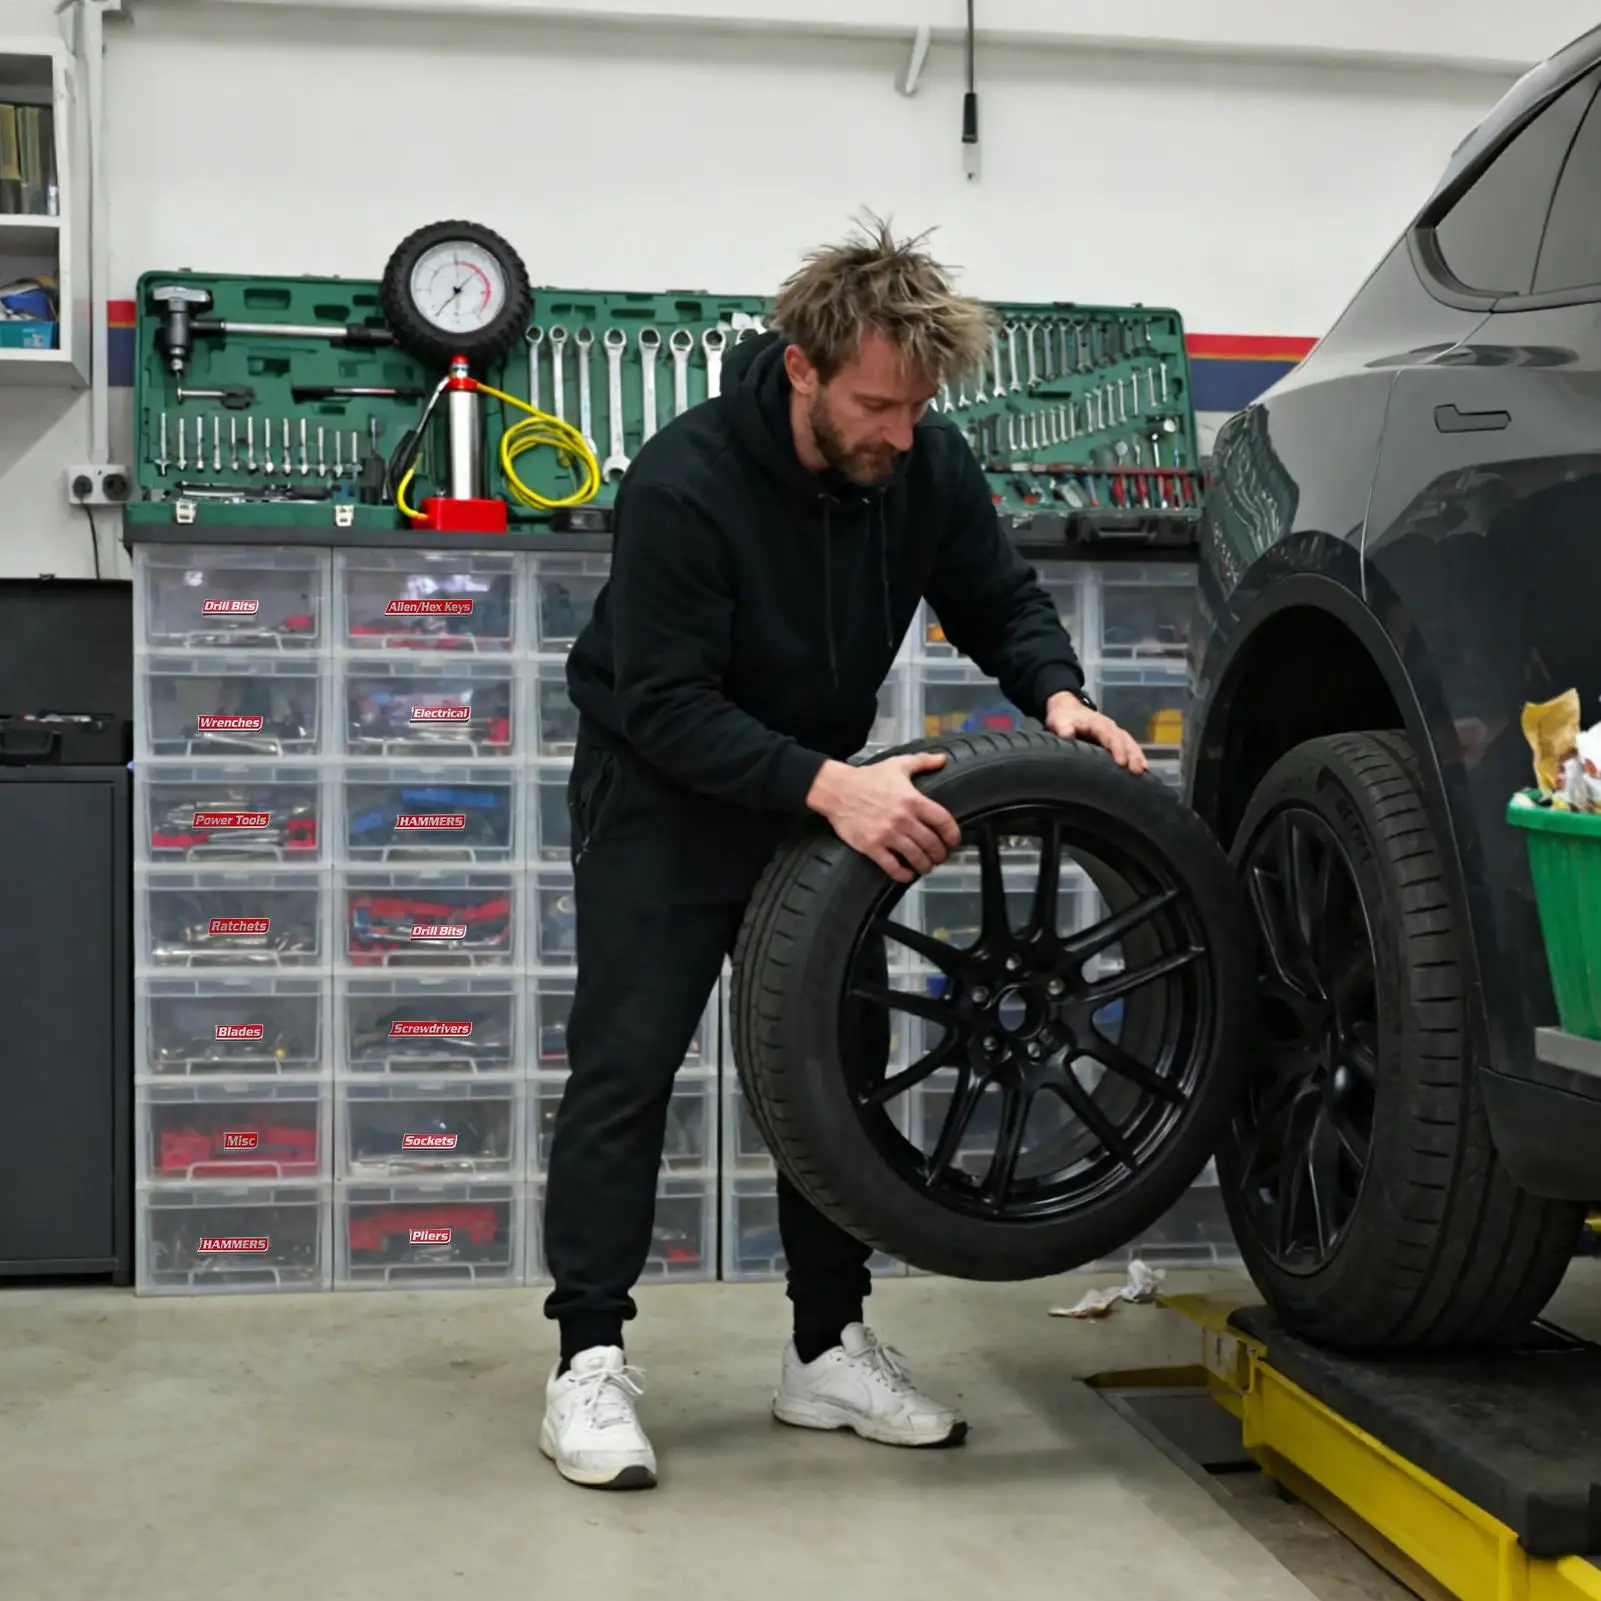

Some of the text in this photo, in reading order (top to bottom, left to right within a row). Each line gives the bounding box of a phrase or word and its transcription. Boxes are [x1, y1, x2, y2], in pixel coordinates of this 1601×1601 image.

[204, 600, 256, 611] Drill Bits
[387, 601, 470, 614] Allen/Hex Keys
[413, 708, 467, 718] Electrical
[200, 718, 260, 728] Wrenches
[196, 815, 266, 825] Power Tools
[400, 816, 463, 826] HAMMERS
[211, 921, 267, 931] Ratchets
[412, 926, 463, 937] Drill Bits
[218, 1027, 260, 1037] Blades
[394, 1024, 469, 1034] Screwdrivers
[227, 1135, 255, 1146] Misc
[405, 1136, 454, 1146] Sockets
[412, 1231, 448, 1241] Pliers
[203, 1239, 265, 1249] HAMMERS
